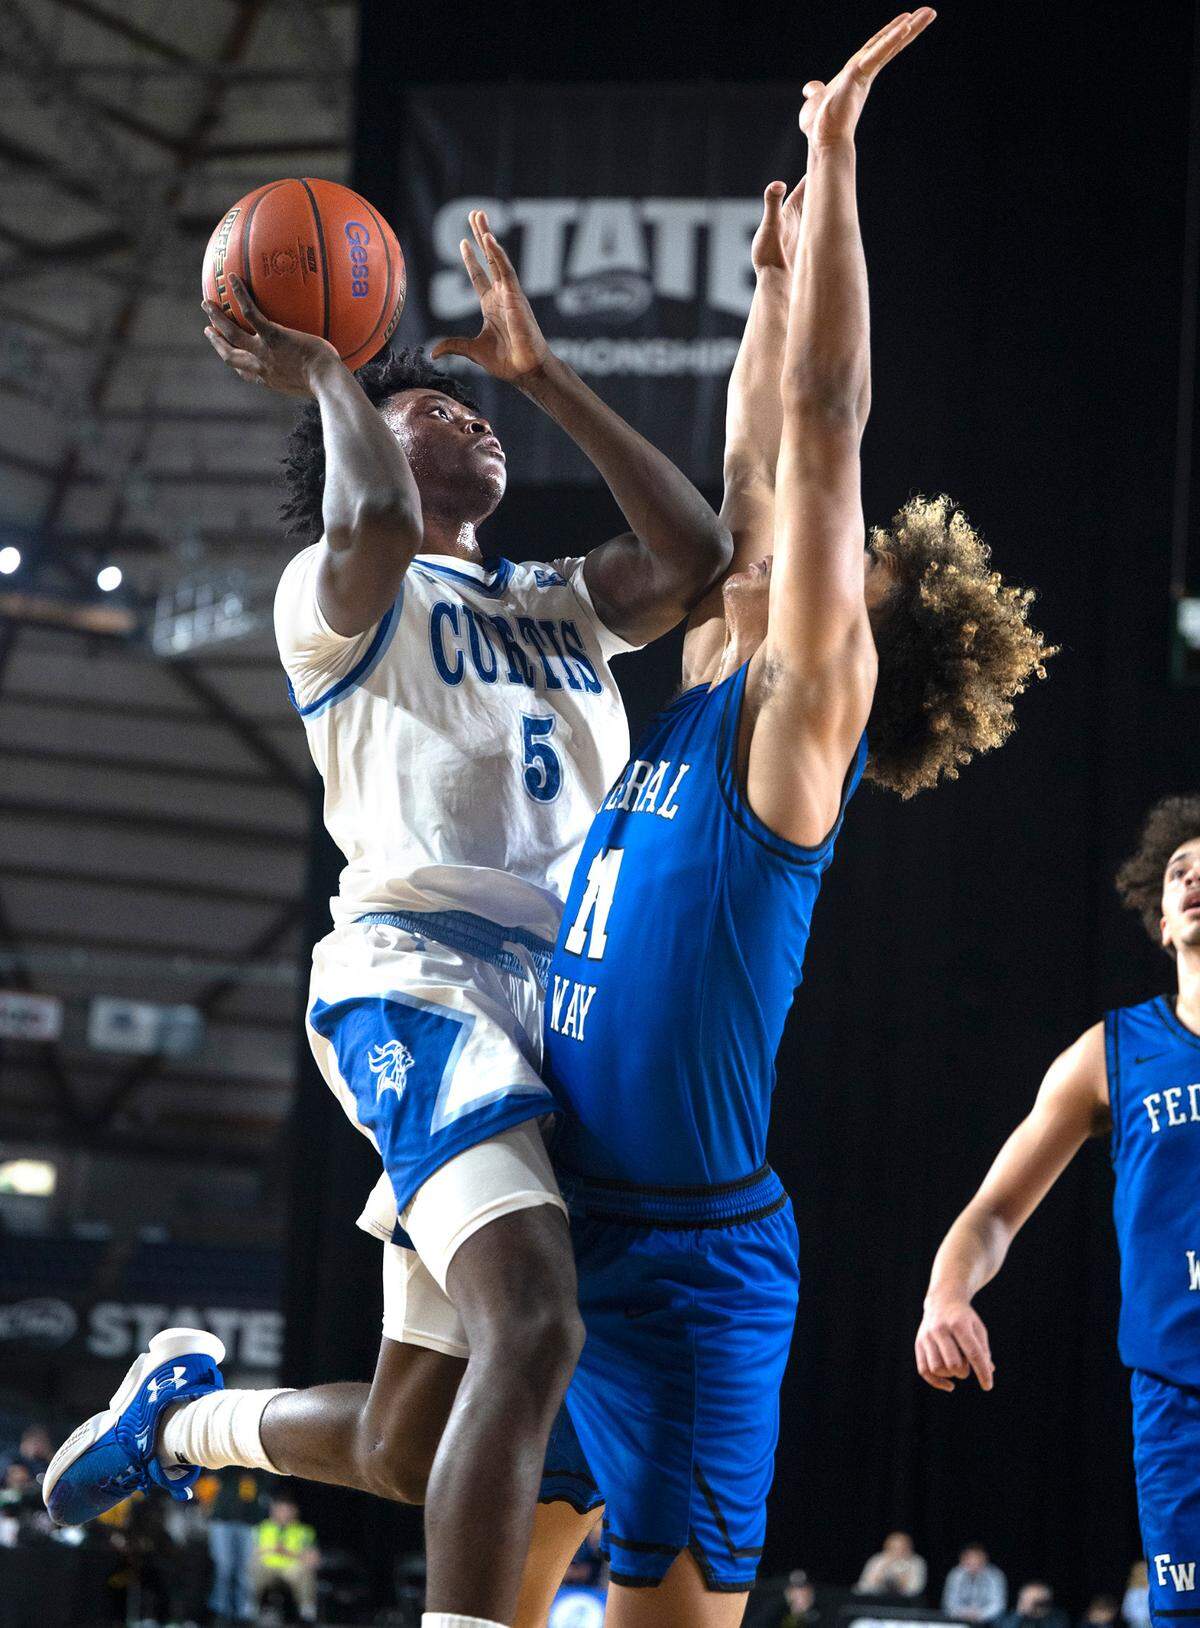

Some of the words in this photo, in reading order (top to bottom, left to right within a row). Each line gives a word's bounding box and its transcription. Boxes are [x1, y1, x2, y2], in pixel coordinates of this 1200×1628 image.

[344, 220, 370, 299] Gesa
[429, 197, 766, 321] STATE
[428, 599, 604, 696] CURTIS
[519, 711, 564, 804] 5
[550, 974, 597, 1042] WAY
[1153, 1553, 1197, 1593] FW
